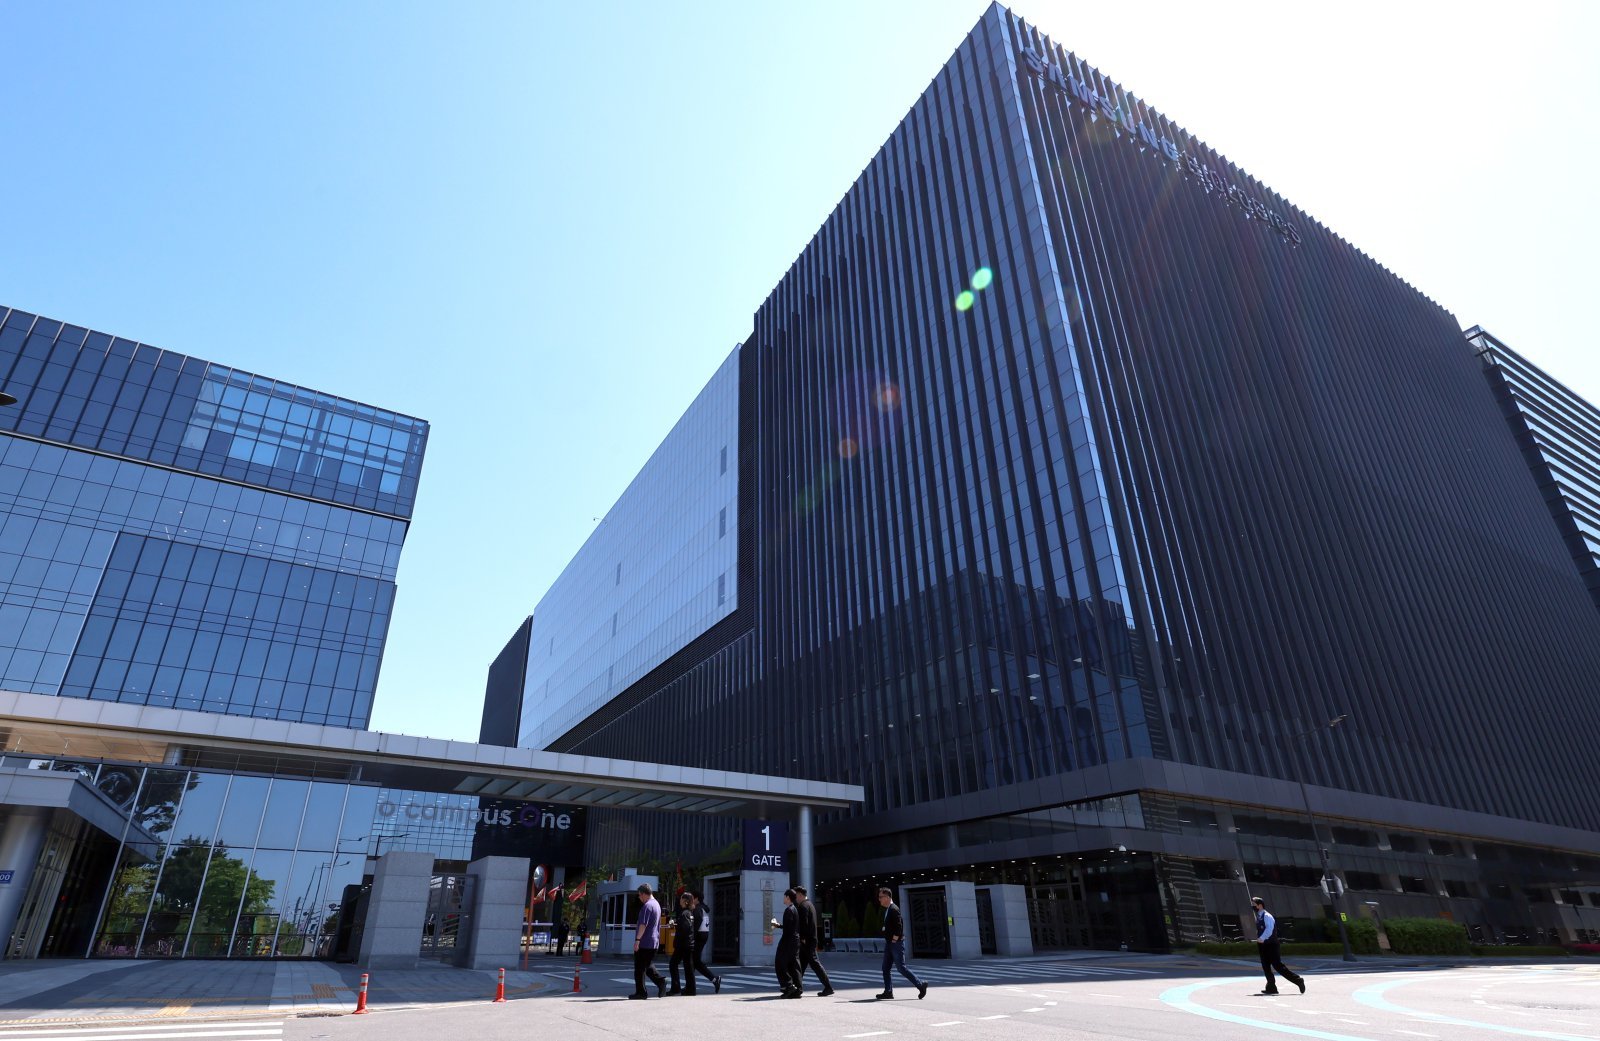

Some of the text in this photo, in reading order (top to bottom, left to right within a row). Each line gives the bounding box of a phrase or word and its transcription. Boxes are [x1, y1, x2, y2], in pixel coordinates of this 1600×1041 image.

[1024, 46, 1179, 162] SAMSUNG
[520, 805, 571, 830] One
[761, 825, 770, 851] 1
[752, 854, 782, 867] GATE
